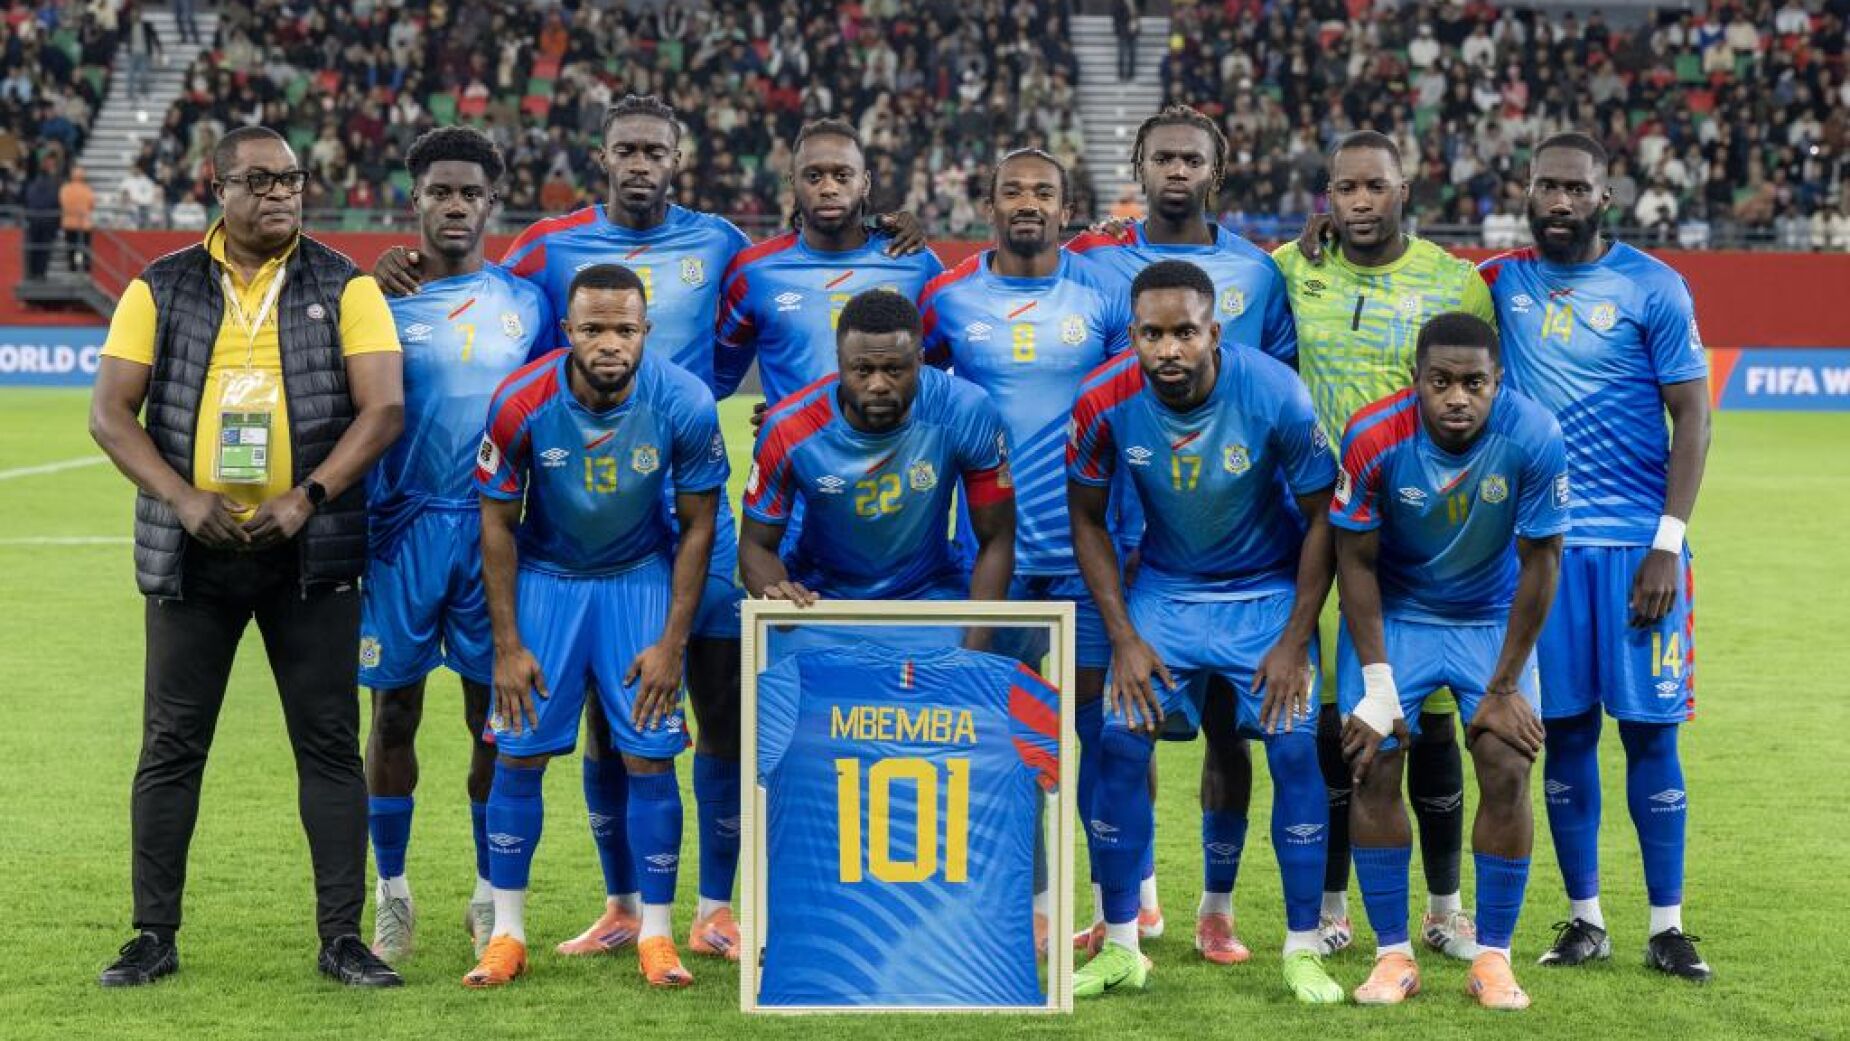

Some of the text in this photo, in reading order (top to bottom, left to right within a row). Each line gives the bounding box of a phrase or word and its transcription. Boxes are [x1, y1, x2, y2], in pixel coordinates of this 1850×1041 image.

[1351, 295, 1365, 331] 1
[1541, 302, 1574, 342] 14
[456, 323, 476, 362] 7
[1014, 322, 1037, 362] 8
[1746, 366, 1819, 395] FIFA
[583, 455, 617, 493] 13
[1172, 455, 1203, 490] 17
[855, 472, 903, 516] 22
[1448, 493, 1468, 526] 11
[1651, 631, 1683, 678] 14
[831, 705, 977, 743] MBEMBA
[835, 758, 970, 882] 101
